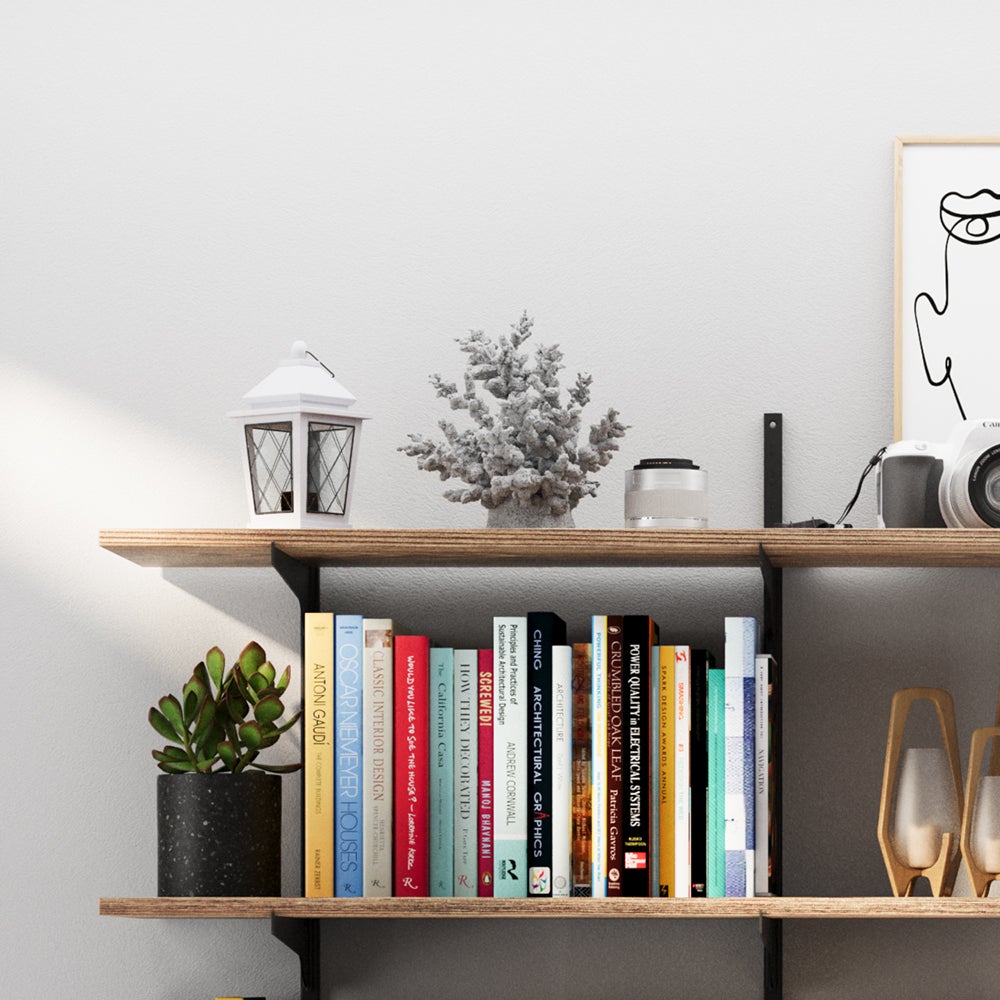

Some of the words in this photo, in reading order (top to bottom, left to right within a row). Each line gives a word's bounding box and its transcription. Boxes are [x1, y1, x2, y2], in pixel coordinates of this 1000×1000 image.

[498, 624, 506, 659] Sustainable
[509, 624, 518, 652] Principles
[533, 629, 542, 670] CHING
[339, 643, 359, 708] OSCAR
[372, 651, 385, 698] CLASSIC
[510, 655, 518, 666] and
[610, 641, 621, 712] CRUMBLED
[630, 644, 639, 674] POWER
[313, 664, 325, 706] ANTONI
[480, 672, 491, 726] SCREWED!
[498, 661, 506, 700] Architectural
[510, 668, 518, 696] Practices
[628, 677, 640, 716] QUALITY
[313, 709, 330, 745] GAUDÍ
[373, 702, 385, 754] INTERIOR
[497, 702, 506, 725] Design
[611, 716, 622, 745] OAK
[340, 712, 359, 797] NIEMEYER
[533, 686, 542, 784] ARCHITECTURAL
[630, 727, 640, 783] ELECTRICAL
[506, 742, 515, 777] ANDREW
[611, 749, 621, 781] LEAF
[373, 759, 384, 801] DESIGN
[482, 780, 490, 809] MANOJ
[506, 780, 515, 825] CORNWALL
[610, 789, 618, 828] Patricia
[630, 785, 640, 827] SYSTEMS
[340, 802, 358, 872] HOUSES
[482, 814, 490, 859] BHAVNANI
[610, 831, 618, 860] Gavros
